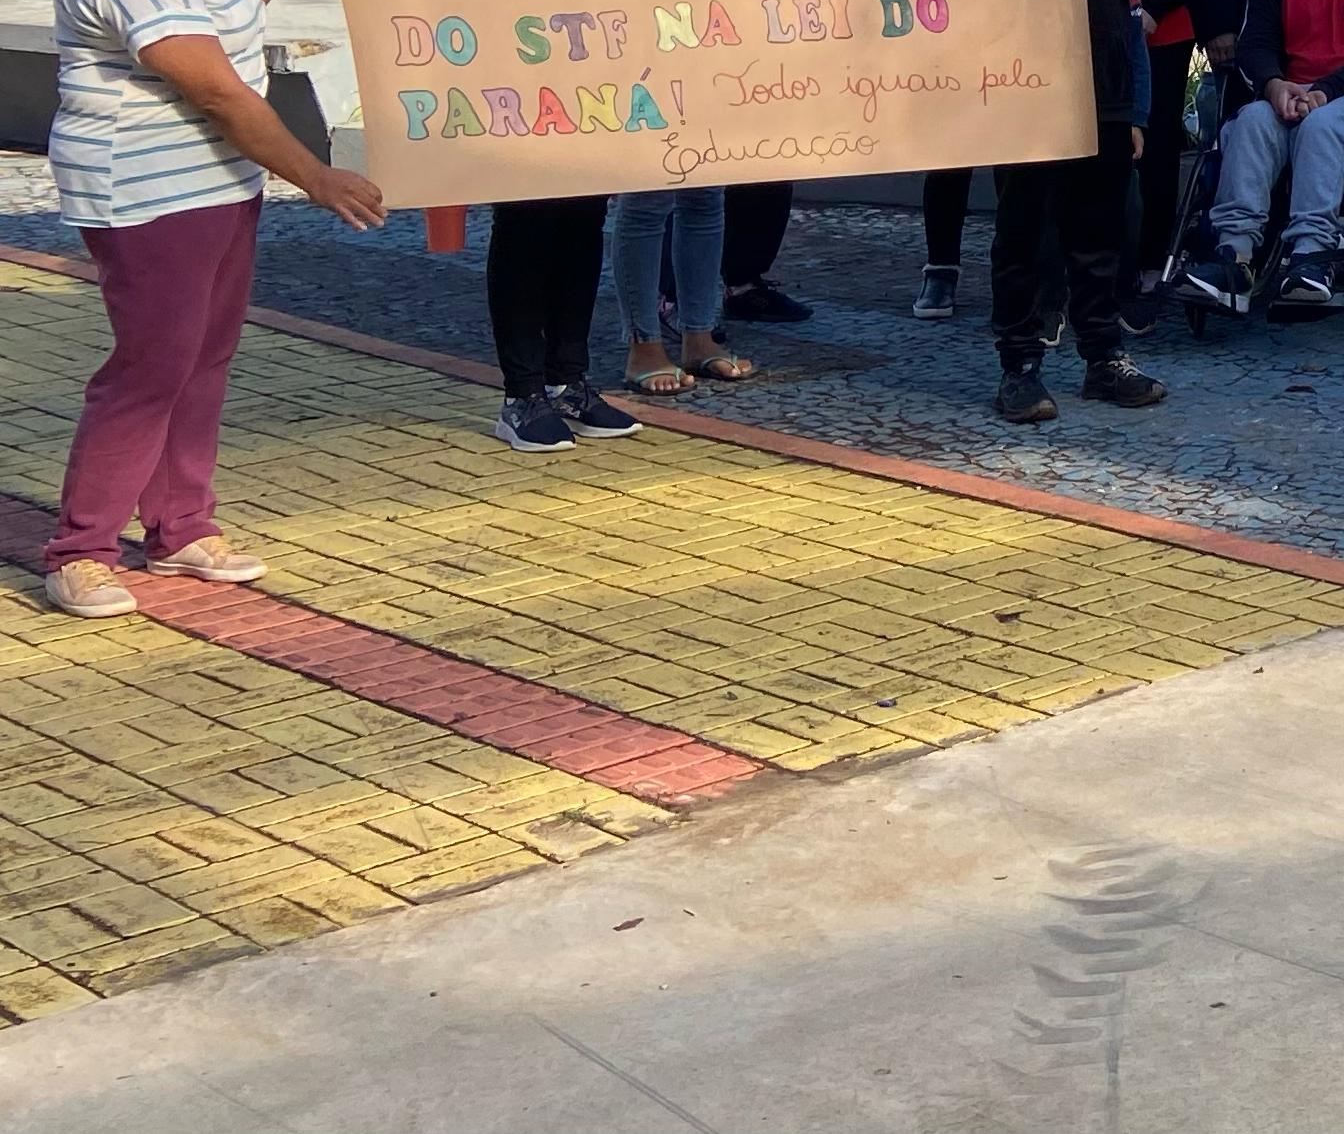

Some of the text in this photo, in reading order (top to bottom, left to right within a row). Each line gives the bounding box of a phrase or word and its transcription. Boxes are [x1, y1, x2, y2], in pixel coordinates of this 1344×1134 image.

[391, 15, 478, 66] DO
[516, 10, 629, 63] STF
[654, 0, 742, 53] NA
[398, 58, 1051, 140] PARANÁ! Todos iguais pela
[661, 130, 881, 184] Educação
